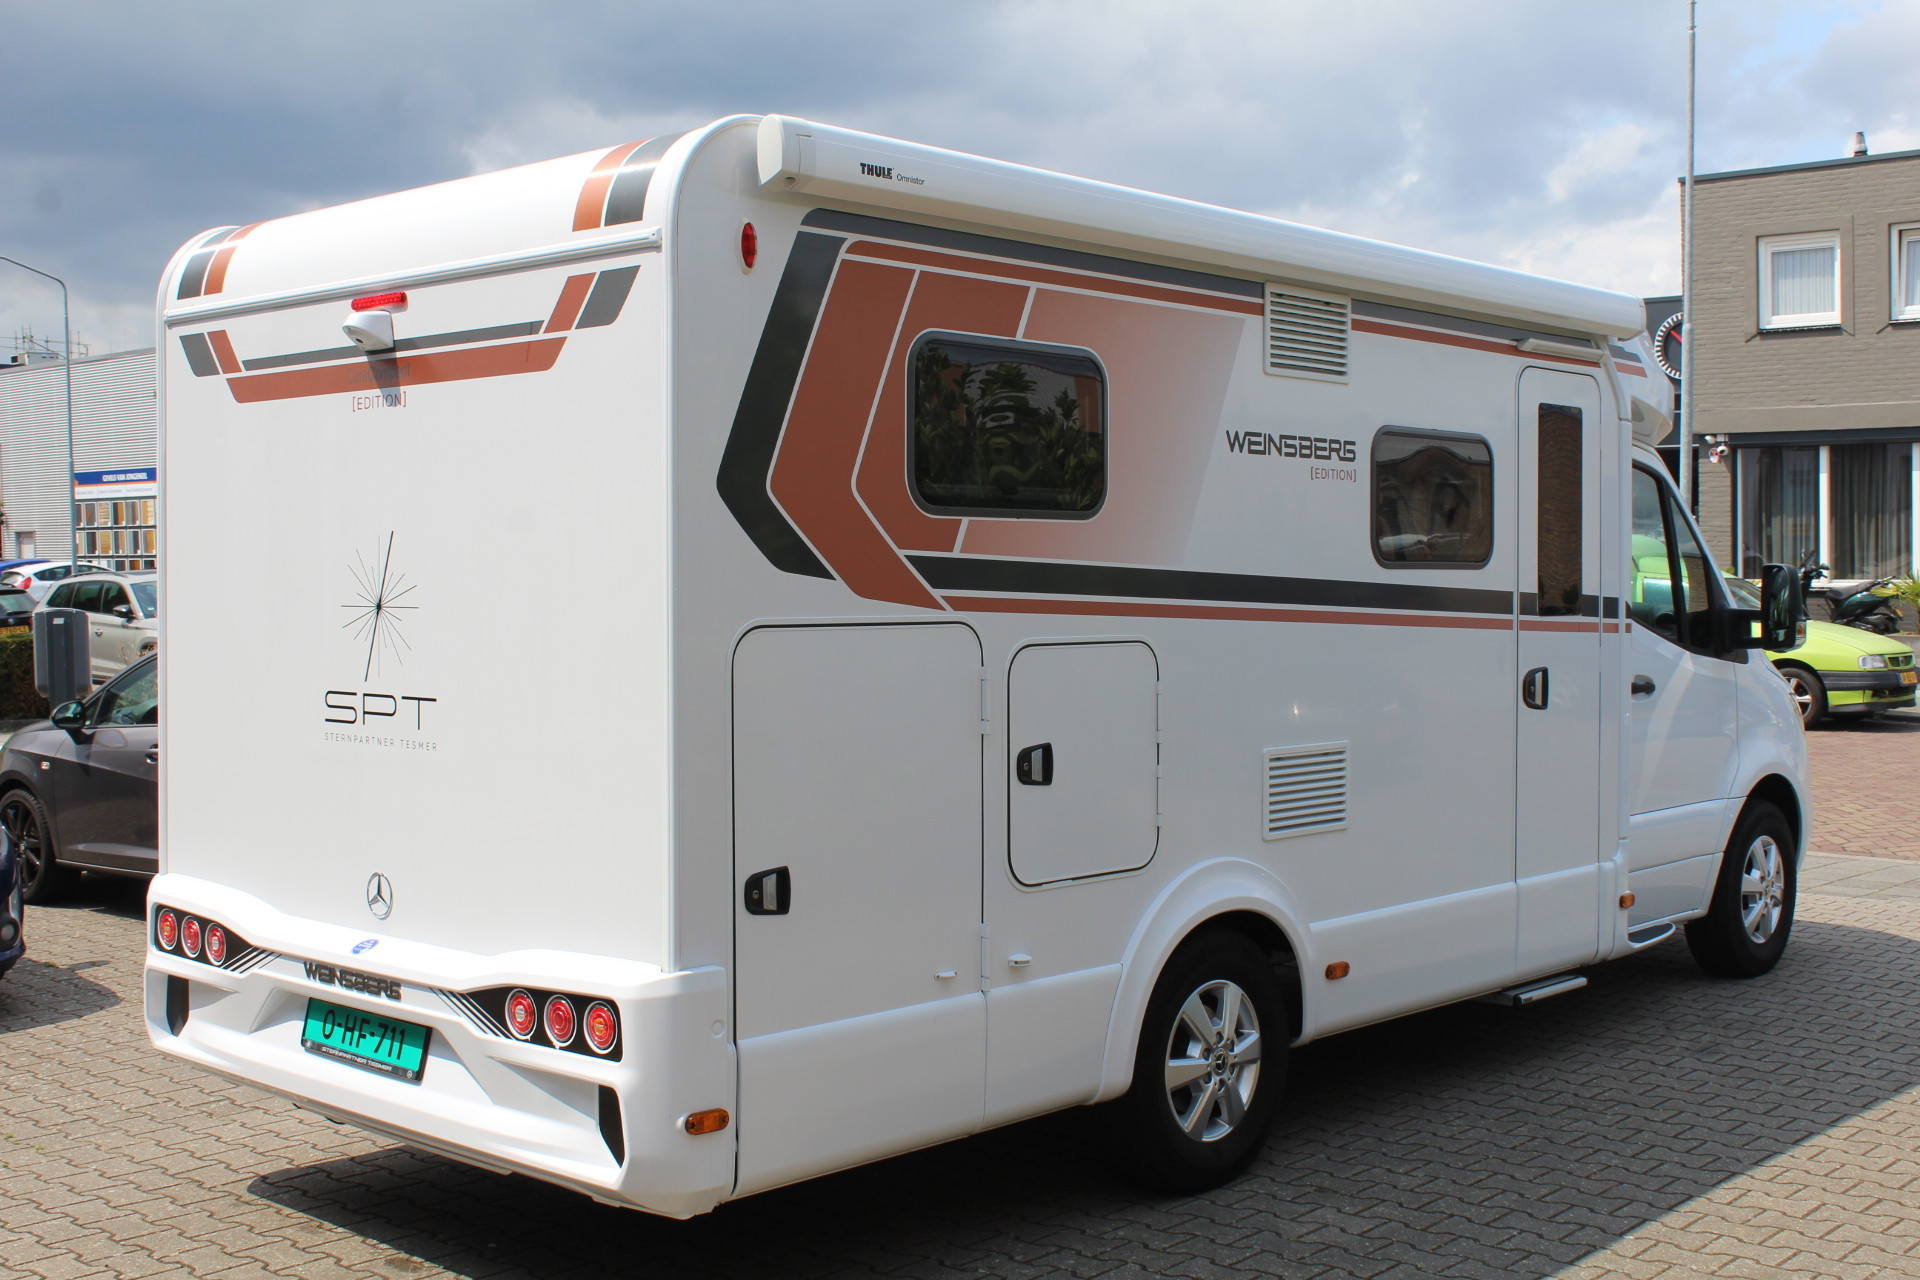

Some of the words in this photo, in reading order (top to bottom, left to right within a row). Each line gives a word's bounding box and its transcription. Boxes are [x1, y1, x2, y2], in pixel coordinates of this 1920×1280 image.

[860, 162, 893, 180] THULE
[896, 173, 925, 186] Omnistor
[1226, 429, 1357, 462] WEINSBERG
[324, 690, 438, 731] SPT
[324, 732, 395, 748] STERNPARTNER
[400, 739, 438, 752] TESMER
[303, 960, 402, 1001] WEINSBERG
